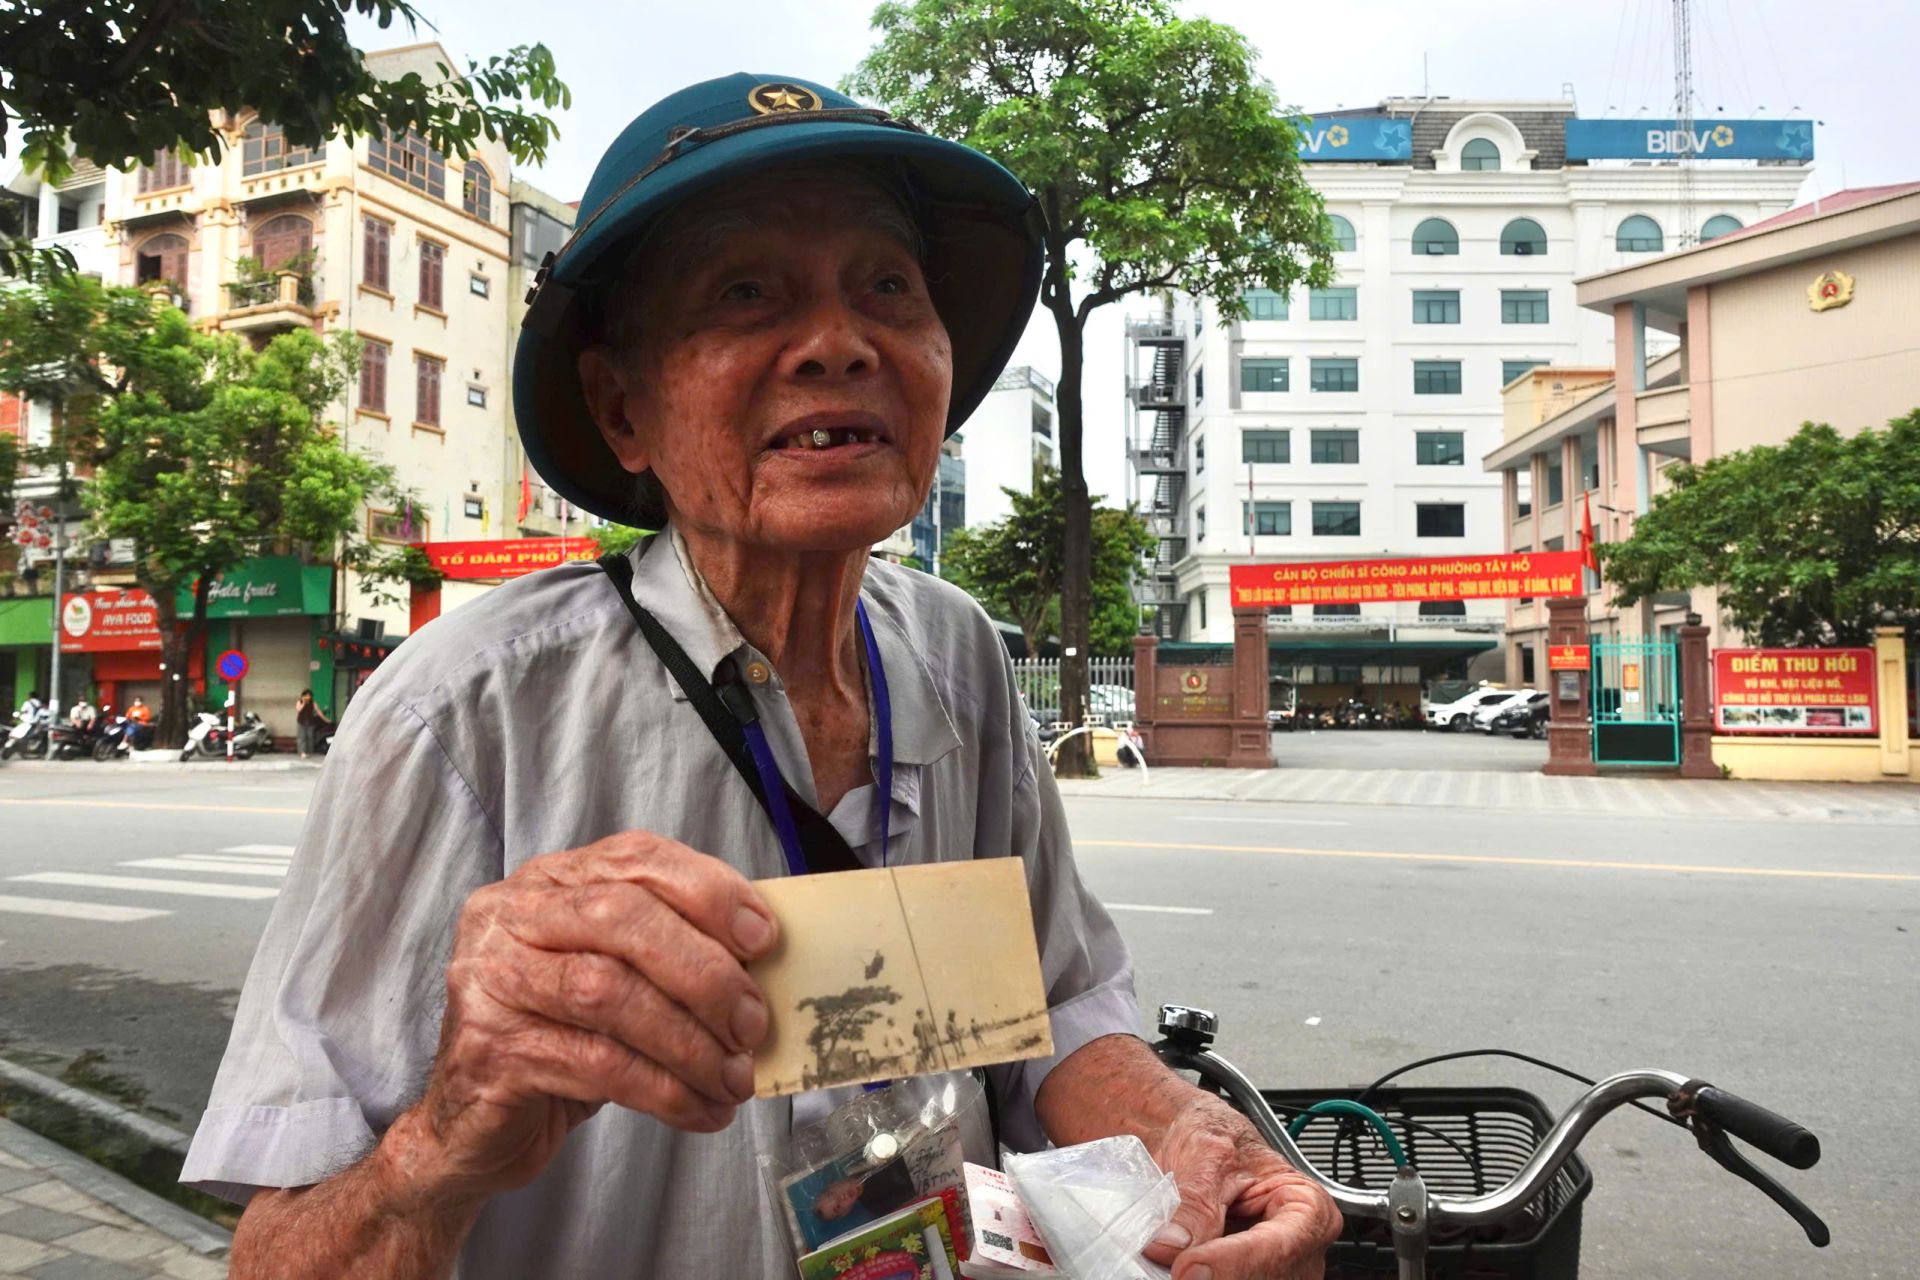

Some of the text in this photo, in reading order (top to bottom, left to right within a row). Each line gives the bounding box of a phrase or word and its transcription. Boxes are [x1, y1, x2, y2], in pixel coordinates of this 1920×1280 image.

[1647, 130, 1711, 153] BIDV
[469, 551, 511, 564] DÂN
[1301, 567, 1318, 582] BỘ
[1320, 565, 1355, 579] CHIẾN
[1370, 563, 1407, 577] CÔNG
[1410, 564, 1428, 576] AN
[1430, 561, 1482, 575] PHƯỜNG
[1485, 559, 1508, 573] TÂY
[1511, 556, 1531, 572] HỒ
[243, 581, 277, 604] fruit
[125, 611, 152, 625] FOOD
[1731, 652, 1858, 673] ĐIỂM THU HỒI
